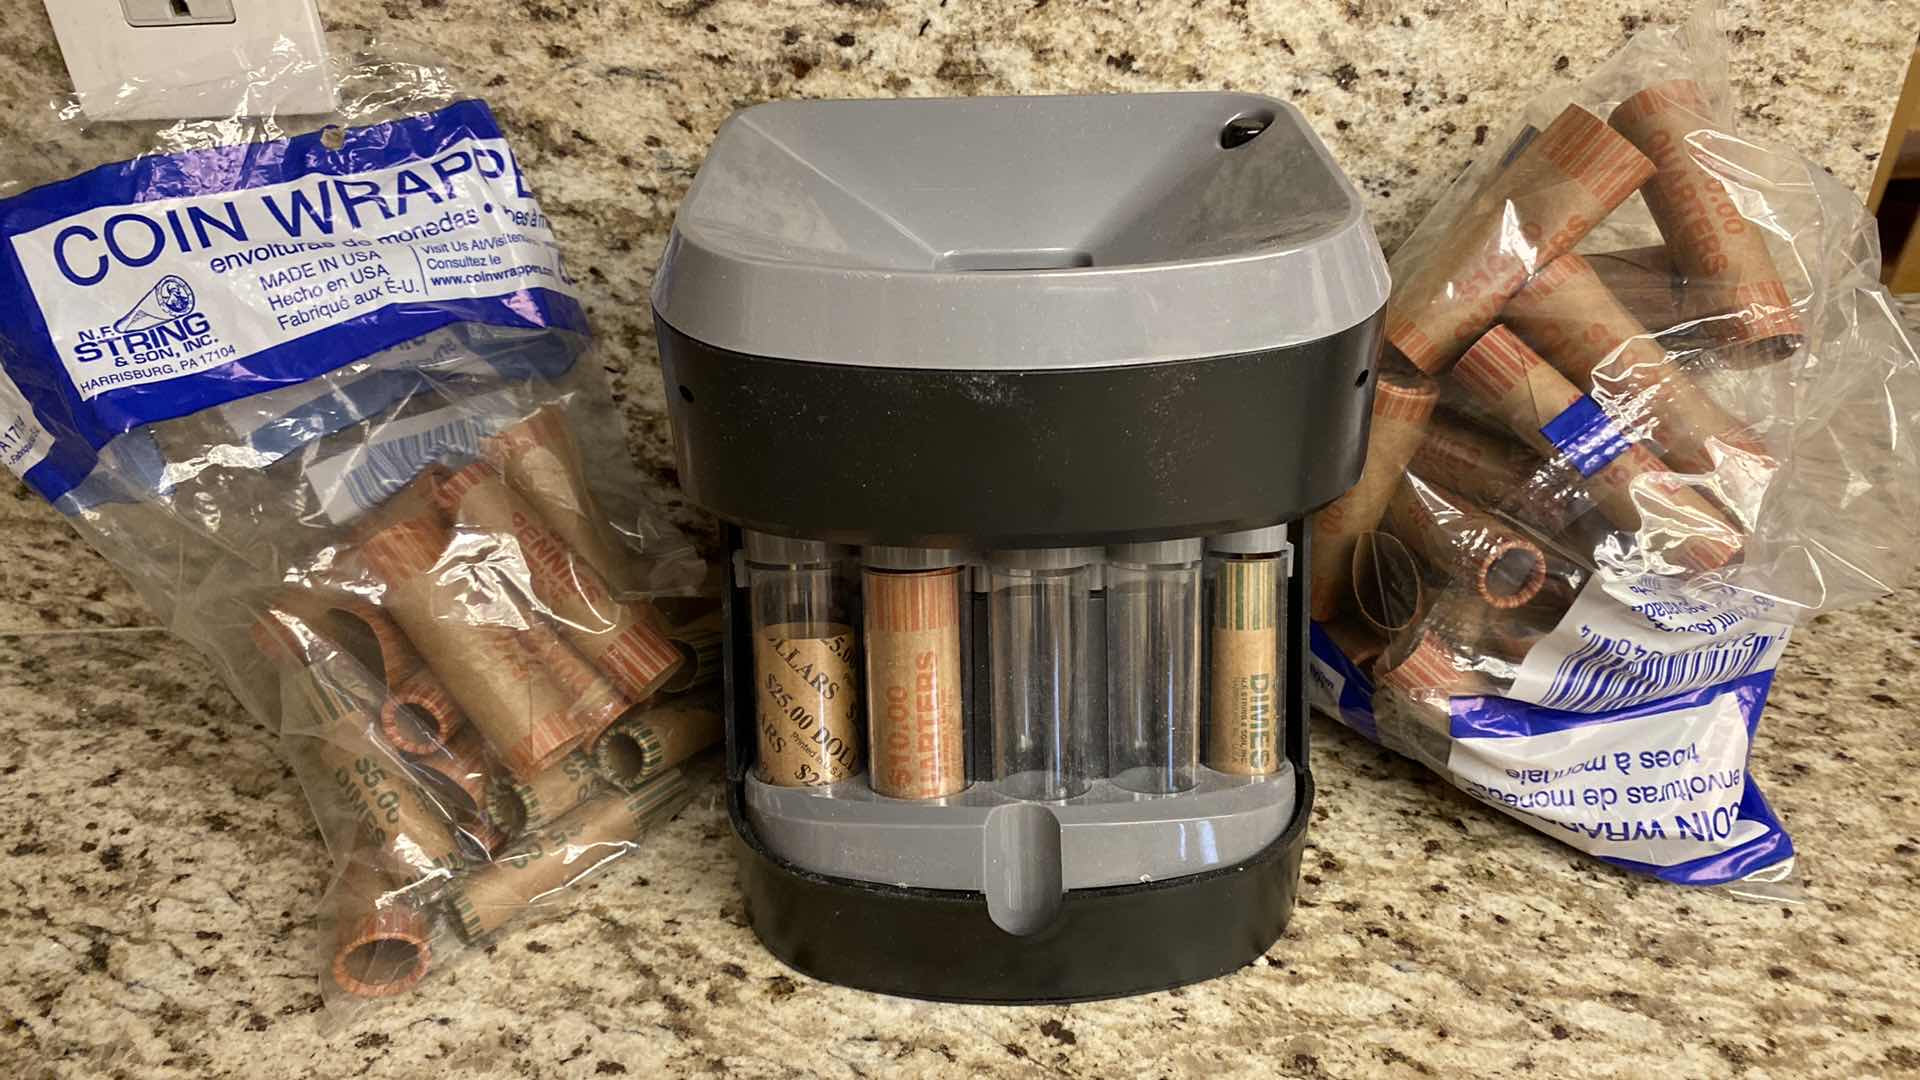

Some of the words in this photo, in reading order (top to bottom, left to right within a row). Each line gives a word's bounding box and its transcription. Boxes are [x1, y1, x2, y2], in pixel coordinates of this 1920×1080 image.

[54, 202, 249, 286] COIN
[210, 241, 335, 274] envolturas
[377, 208, 480, 245] monedas
[421, 243, 449, 255] Visit
[451, 240, 468, 253] Us
[426, 257, 487, 270] Consultez
[489, 254, 502, 265] le
[259, 262, 315, 291] MADE
[319, 257, 340, 273] IN
[343, 249, 382, 266] USA
[268, 282, 323, 312] Hecho
[327, 277, 348, 292] en
[350, 263, 391, 285] USA
[276, 295, 350, 331] Fabriqué
[354, 286, 384, 306] aux
[384, 276, 420, 295] É-U.
[74, 312, 211, 363] STRING
[78, 325, 115, 343] N.F.
[114, 356, 129, 368] &
[135, 347, 181, 366] SON,
[183, 334, 219, 353] INC.
[80, 364, 178, 393] HARRISBURG,
[180, 358, 199, 371] PA
[199, 344, 237, 364] 17104
[765, 672, 814, 730] $25.00
[1249, 673, 1270, 768] DIMES
[886, 686, 912, 785] $10.00
[1614, 751, 1631, 775] à
[1626, 768, 1740, 804] envolturas
[1583, 787, 1618, 811] de
